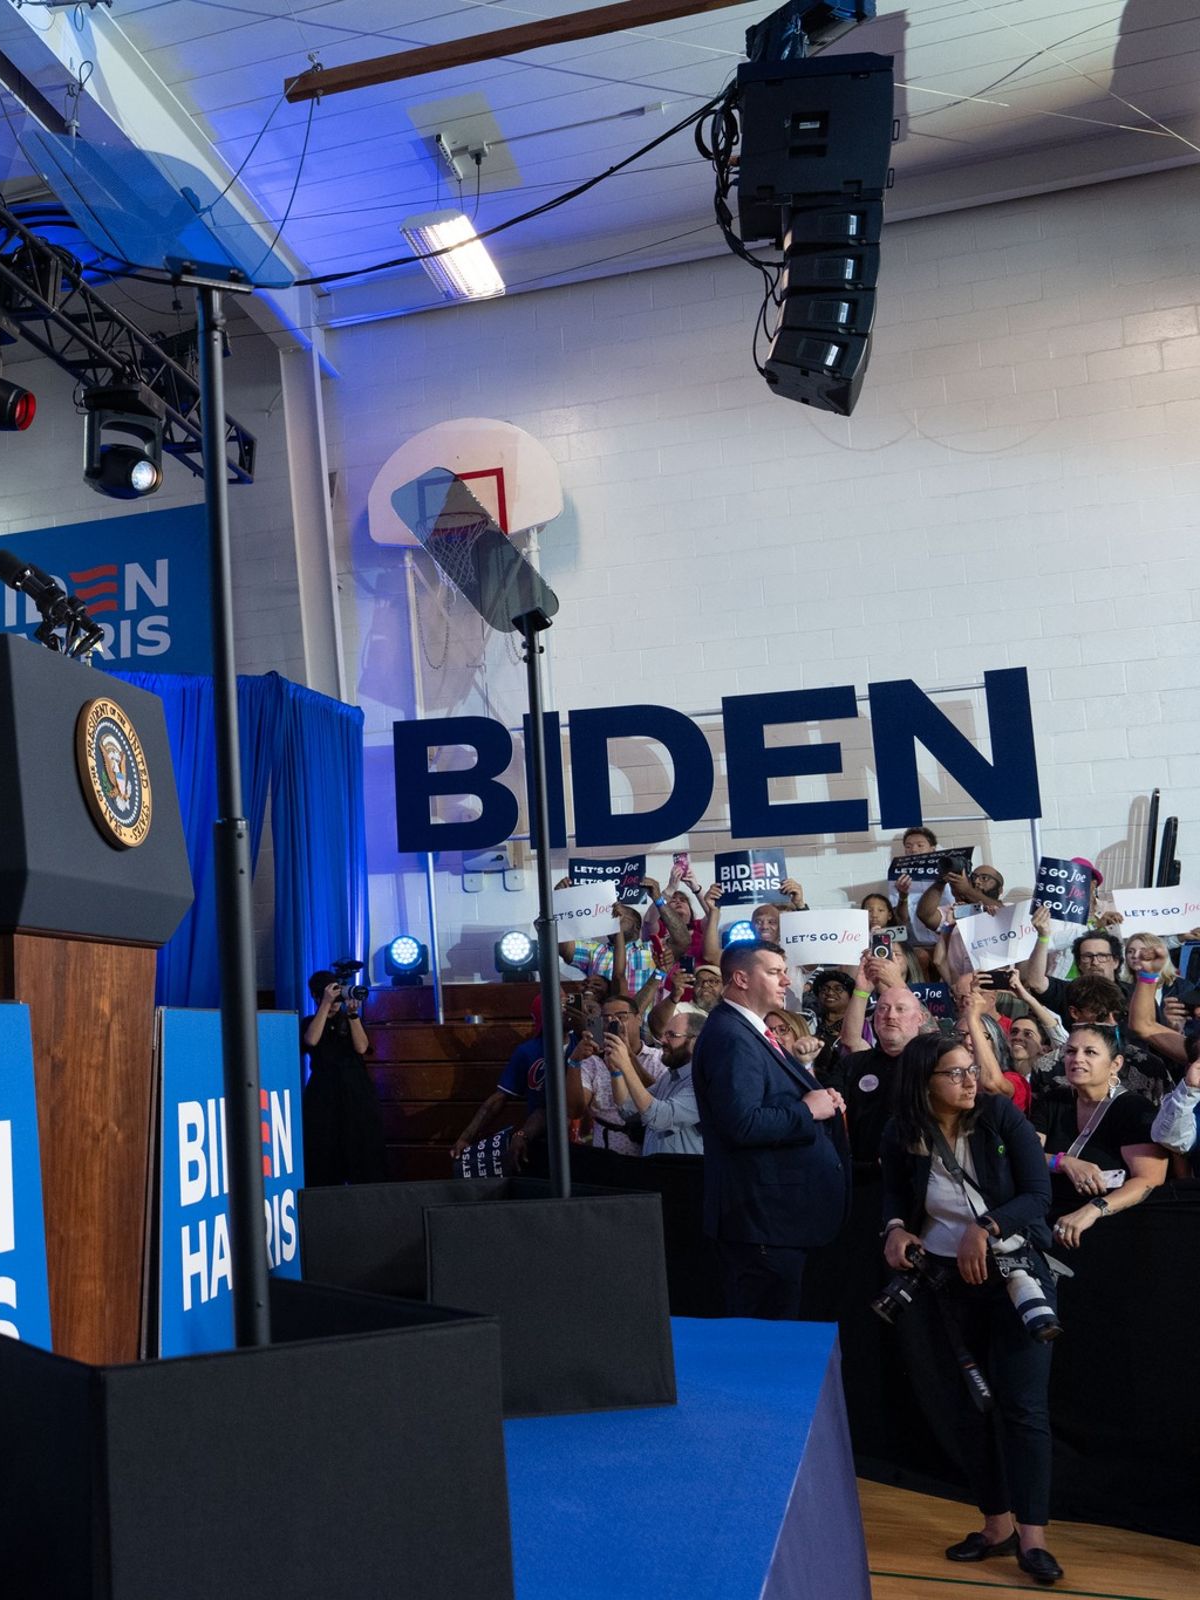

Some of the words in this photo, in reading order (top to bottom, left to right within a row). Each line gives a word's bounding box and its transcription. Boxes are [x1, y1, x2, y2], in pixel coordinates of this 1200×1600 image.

[88, 703, 109, 760] PRESIDENT
[128, 728, 149, 789] UNITED
[392, 666, 1042, 853] BIDEN
[131, 801, 150, 841] STATES
[574, 865, 604, 874] LET'S
[605, 866, 621, 874] GO
[620, 862, 639, 875] Joe
[720, 862, 779, 881] BIDEN
[1048, 868, 1068, 879] GO
[1067, 868, 1086, 883] Joe
[620, 875, 639, 888] Joe
[721, 877, 781, 893] HARRIS
[619, 887, 639, 900] Joe
[1045, 884, 1066, 895] GO
[1065, 885, 1085, 899] Joe
[553, 910, 574, 921] ET'S
[576, 908, 591, 917] GO
[592, 903, 613, 918] Joe
[1043, 900, 1063, 910] GO
[1062, 901, 1084, 915] Joe
[1124, 908, 1159, 917] LET'S
[1161, 907, 1180, 916] GO
[785, 933, 817, 944] LET'S
[820, 932, 838, 941] GO
[838, 929, 861, 944] Joe
[971, 937, 998, 950] LET'S
[999, 930, 1017, 942] GO
[922, 988, 942, 1001] Joe
[178, 1089, 293, 1207] BIN
[492, 1134, 501, 1148] GO
[462, 1153, 471, 1178] ET'S
[477, 1151, 487, 1178] ET'S
[492, 1149, 503, 1178] ET'S
[181, 1188, 296, 1312] HAIS
[968, 1368, 991, 1398] SONY
